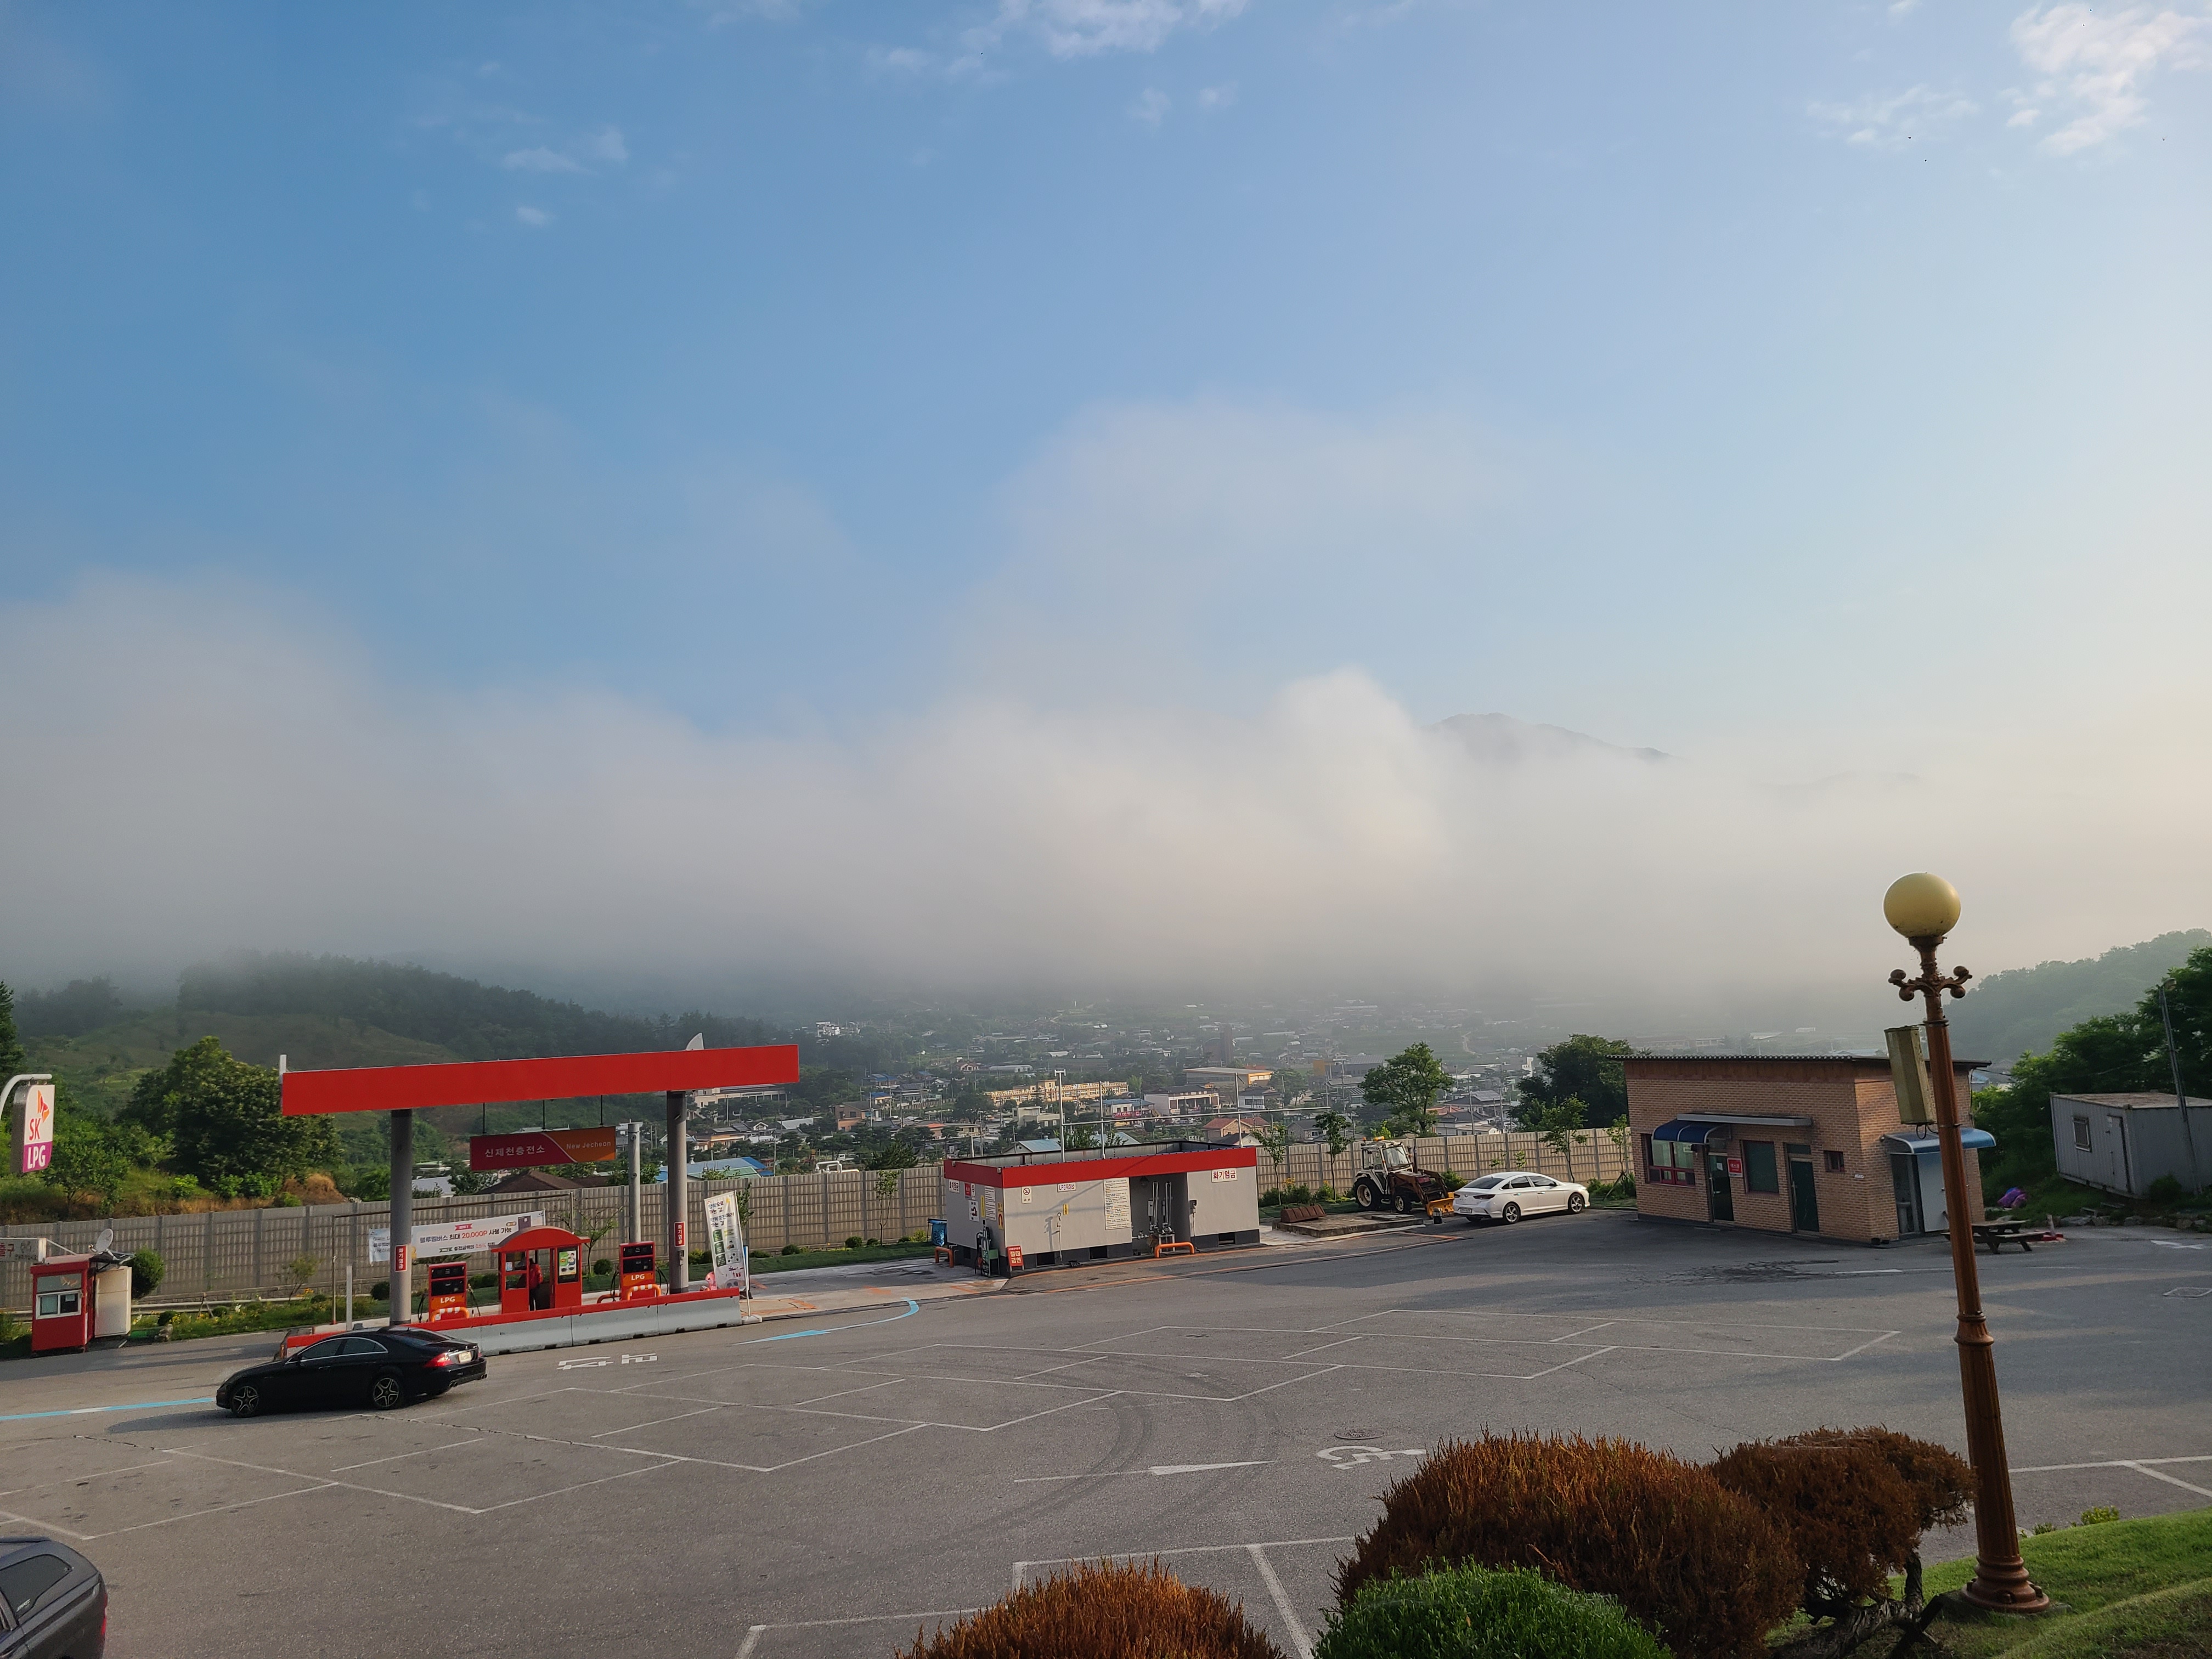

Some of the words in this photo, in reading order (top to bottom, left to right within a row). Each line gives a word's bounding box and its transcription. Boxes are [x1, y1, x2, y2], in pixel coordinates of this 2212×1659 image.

[29, 1118, 41, 1141] SK
[27, 1145, 46, 1169] LPG
[485, 1146, 545, 1158] 신제천충전소
[1213, 1170, 1235, 1180] 화기엄금
[461, 1231, 487, 1239] 20,000P
